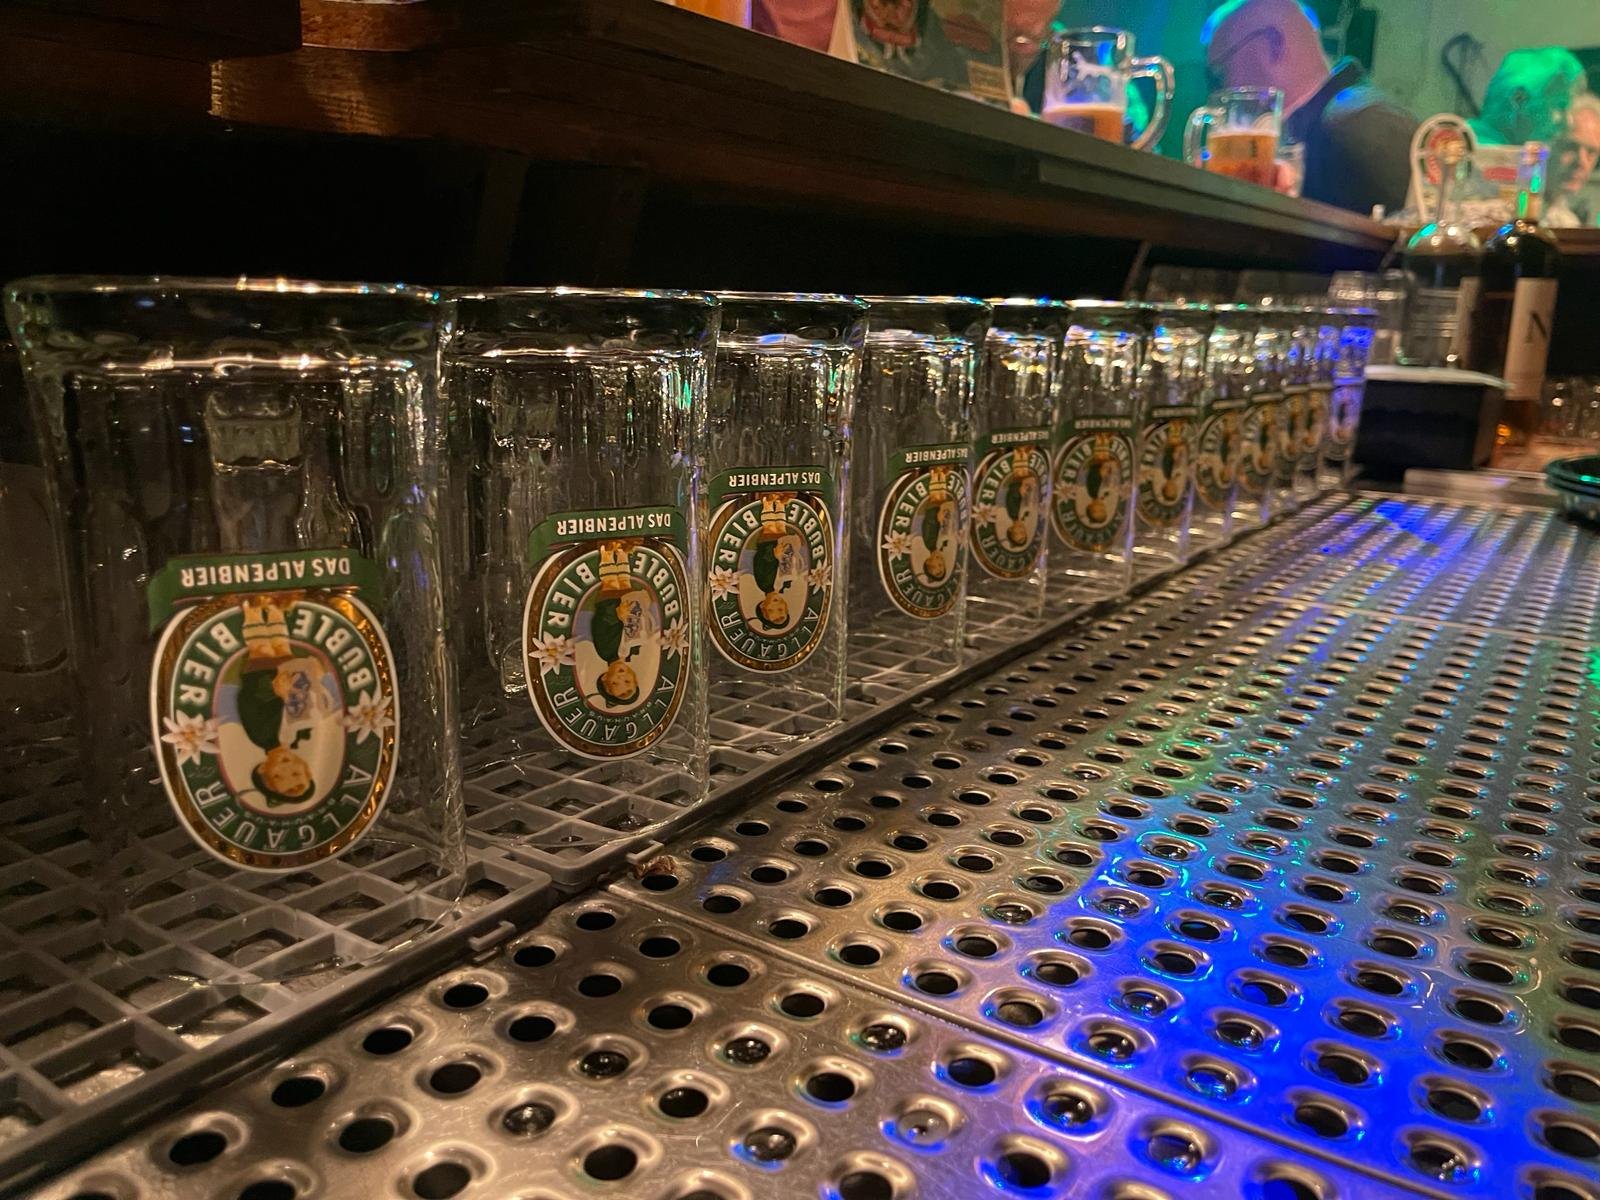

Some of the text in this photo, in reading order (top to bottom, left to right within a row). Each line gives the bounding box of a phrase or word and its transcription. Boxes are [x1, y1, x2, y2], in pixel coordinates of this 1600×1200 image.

[729, 472, 821, 487] DAS ALPENBIER
[905, 448, 957, 464] ALPENBIER
[982, 459, 1011, 499] BIER
[557, 513, 671, 536] DAS ALPENBIER
[788, 502, 824, 559] BÜBLE
[894, 481, 927, 528] BIER
[719, 509, 760, 566] BIER
[181, 557, 351, 588] DAS ALPENBIER
[547, 561, 597, 629] BIER
[632, 551, 680, 618] BÜBLE
[179, 620, 242, 706] BIER
[292, 607, 371, 693] BÜBLE
